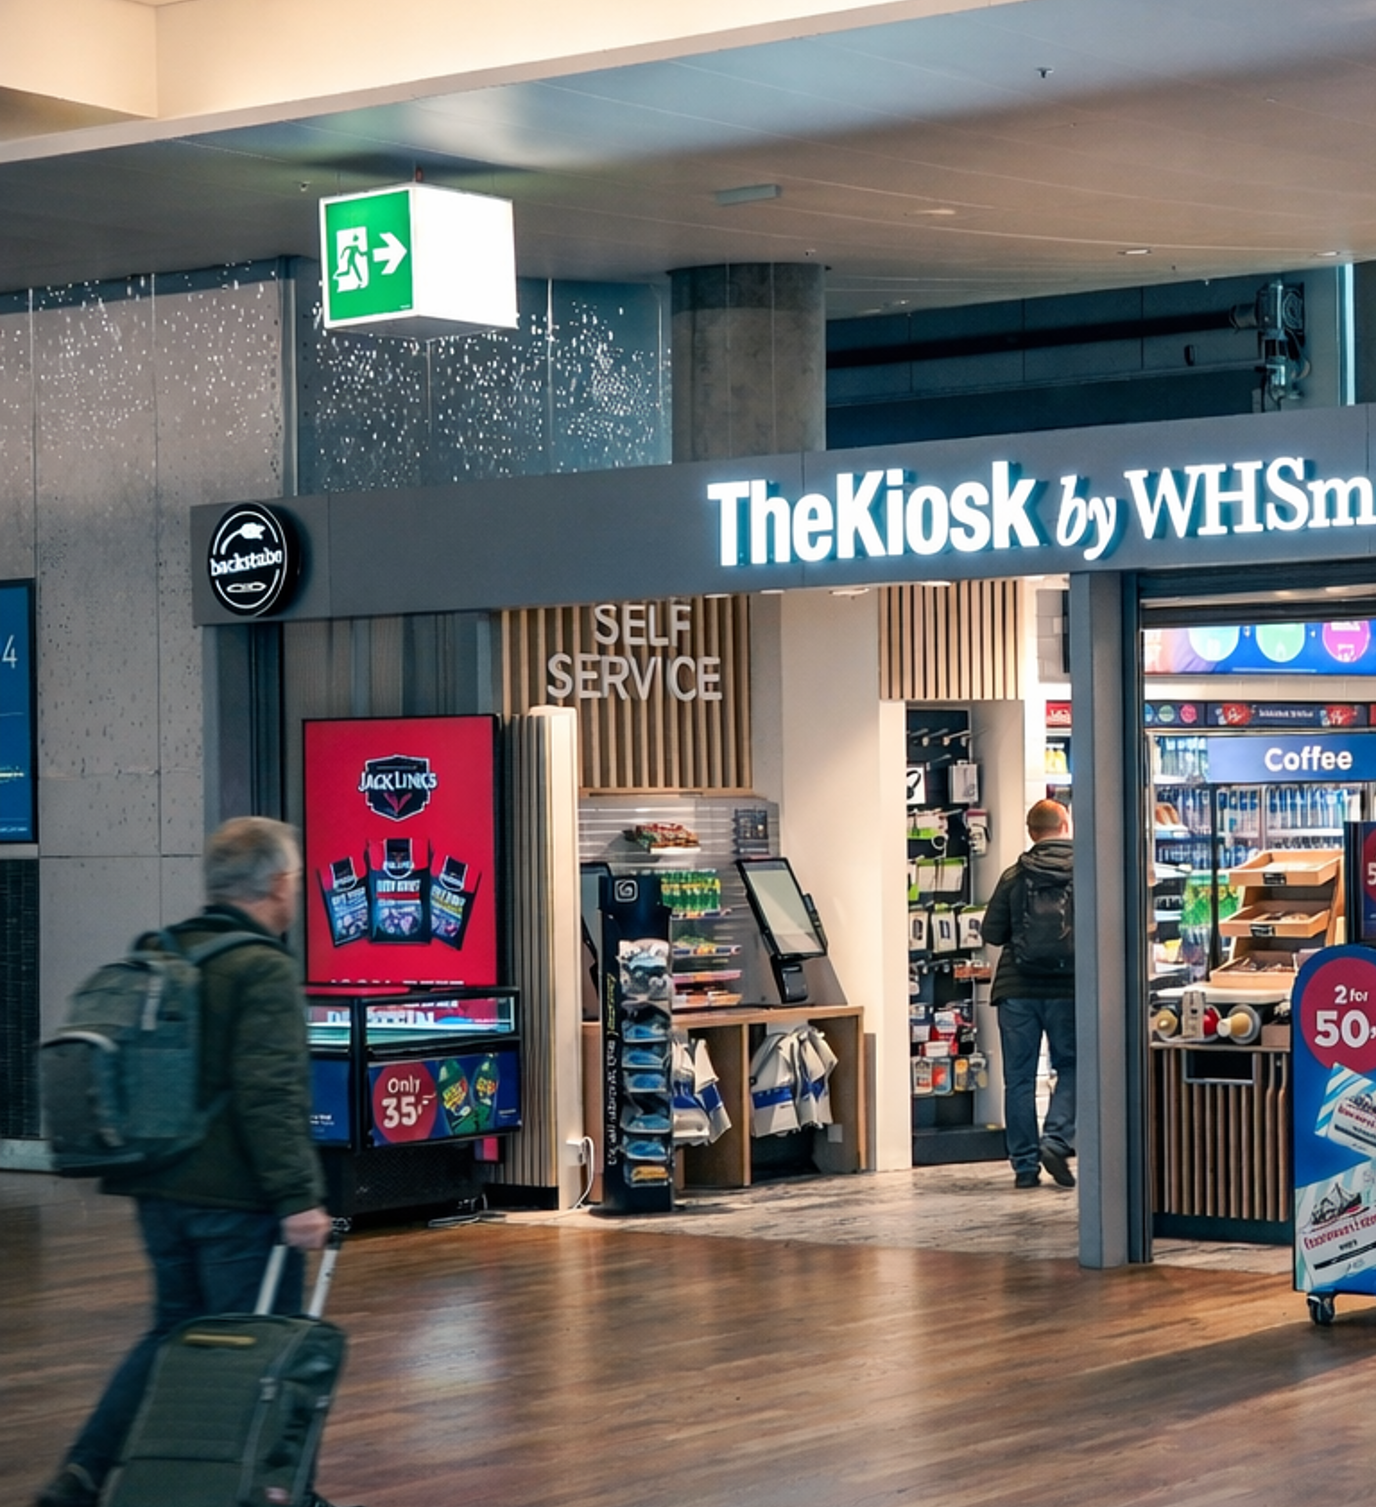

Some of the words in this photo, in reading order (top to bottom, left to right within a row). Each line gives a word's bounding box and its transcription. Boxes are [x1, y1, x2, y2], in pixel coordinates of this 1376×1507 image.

[707, 460, 1040, 567] TheKiosk
[1056, 475, 1117, 560] by
[594, 603, 691, 647] SELF
[547, 652, 722, 701] SERVICE
[1264, 746, 1353, 772] Coffee
[358, 771, 395, 792] JACK
[1334, 984, 1348, 1005] 2
[387, 1075, 421, 1095] Only
